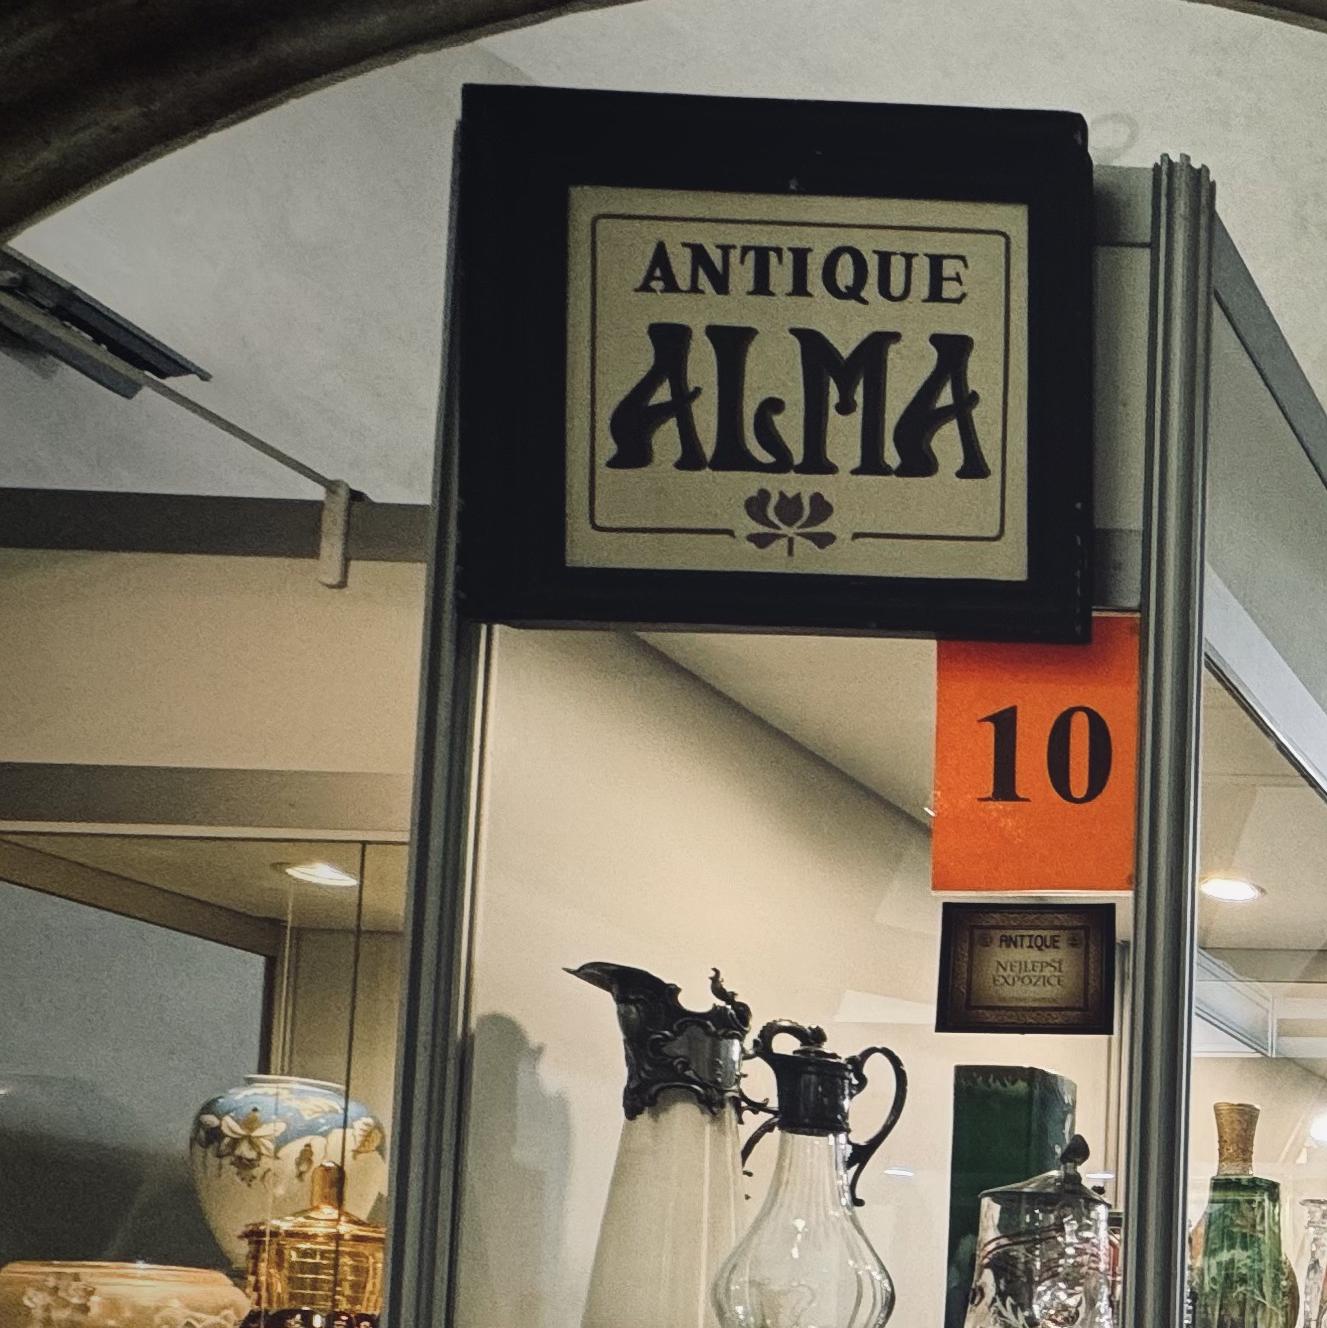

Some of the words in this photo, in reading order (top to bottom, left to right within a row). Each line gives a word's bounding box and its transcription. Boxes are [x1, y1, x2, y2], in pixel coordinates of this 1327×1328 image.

[634, 240, 969, 305] ANTIQUE
[605, 322, 991, 479] ALMA
[977, 705, 1113, 804] 10
[999, 934, 1061, 951] ANTIQUE
[992, 974, 1064, 988] EXPOZICE
